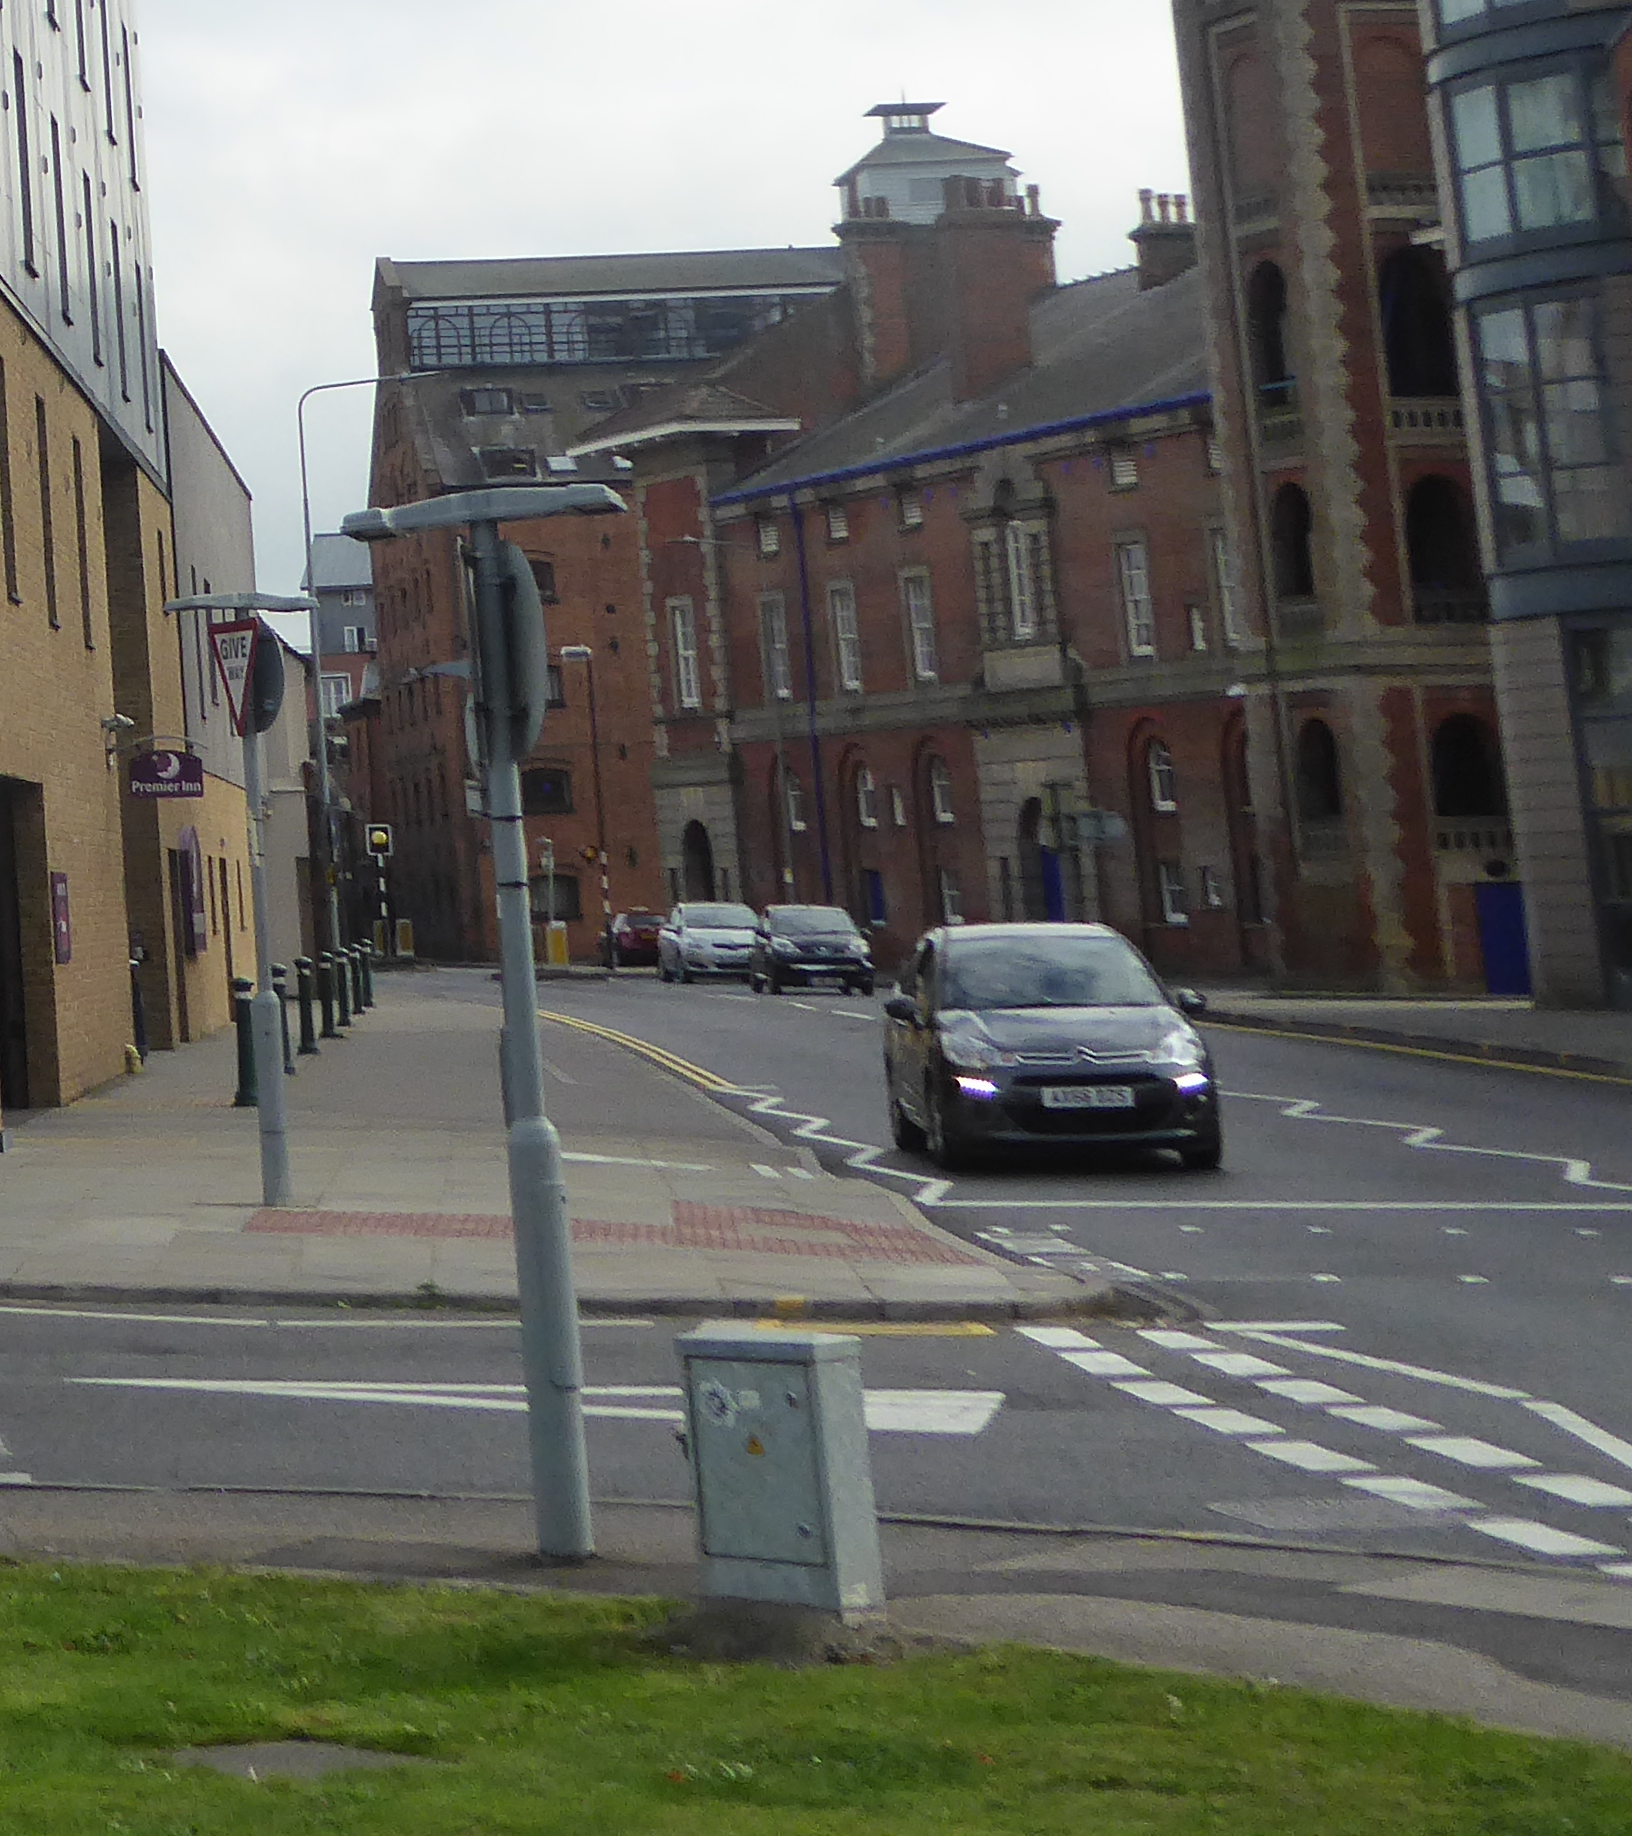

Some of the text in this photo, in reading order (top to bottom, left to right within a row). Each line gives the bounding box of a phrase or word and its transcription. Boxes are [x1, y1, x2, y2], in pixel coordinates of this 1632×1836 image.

[220, 636, 247, 660] GIVE
[131, 780, 201, 793] Premier Inn
